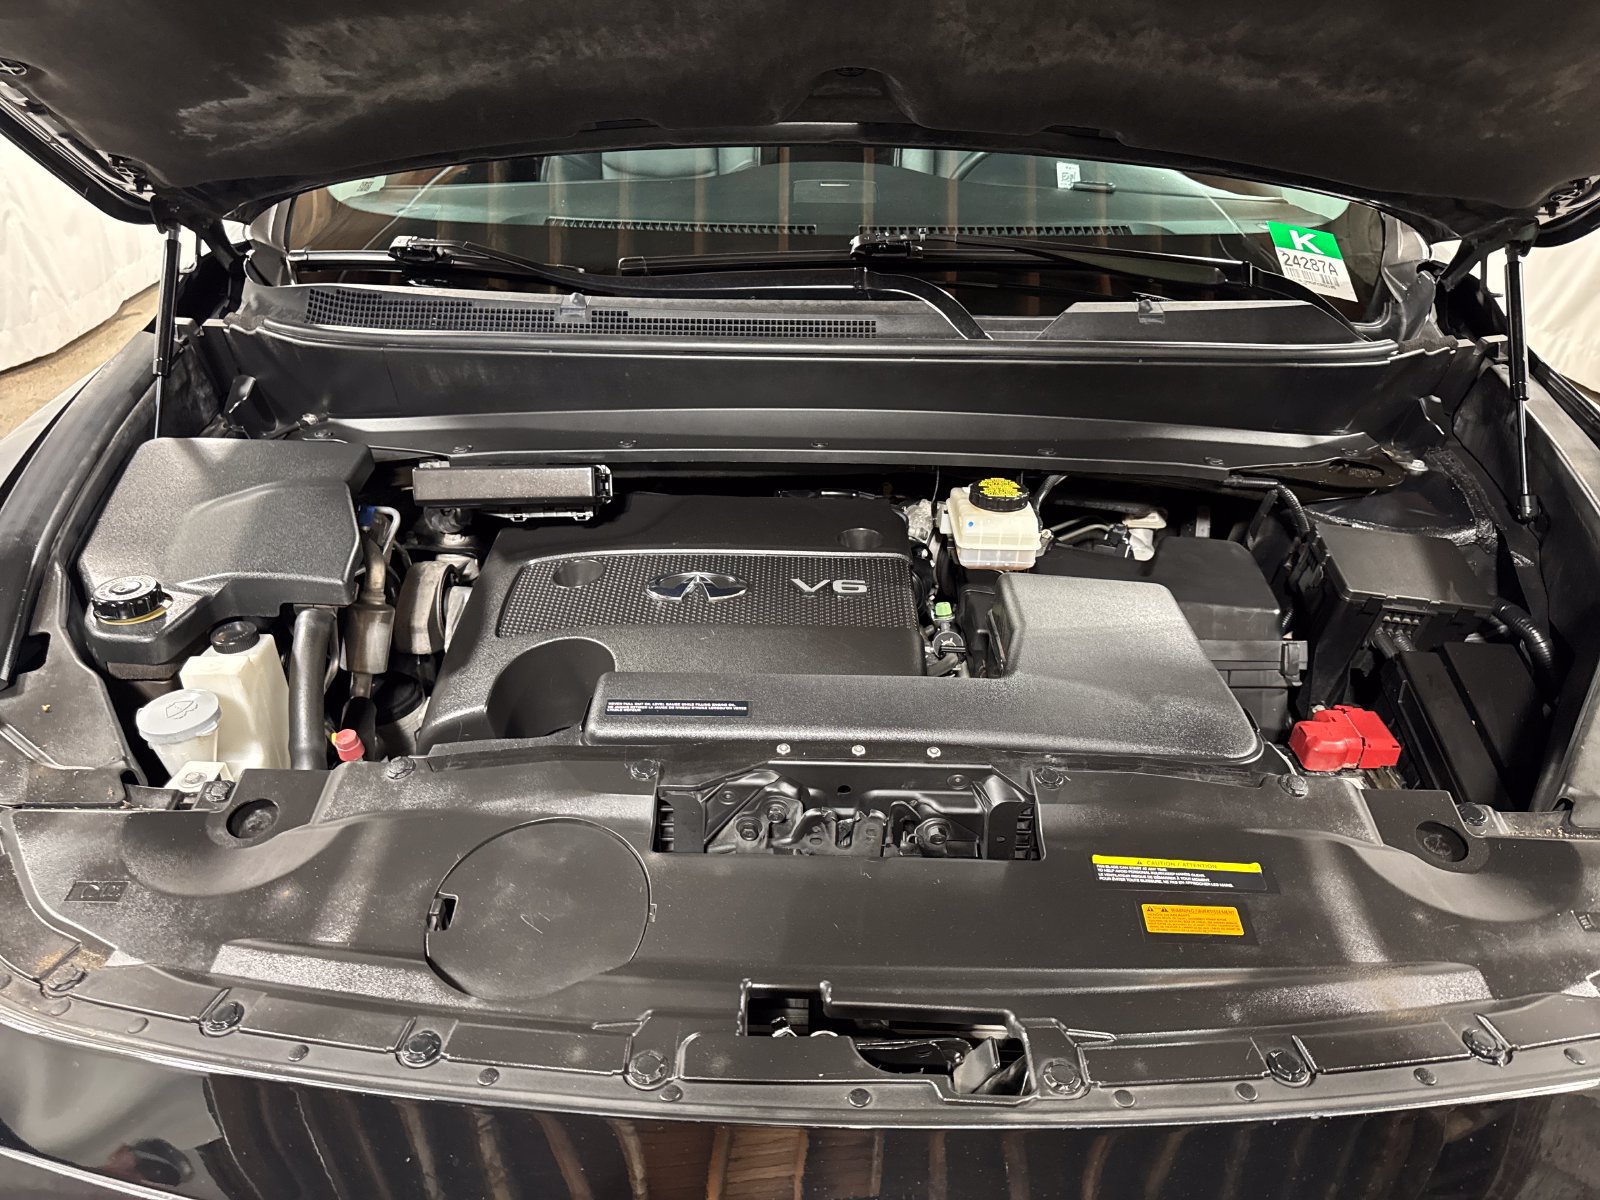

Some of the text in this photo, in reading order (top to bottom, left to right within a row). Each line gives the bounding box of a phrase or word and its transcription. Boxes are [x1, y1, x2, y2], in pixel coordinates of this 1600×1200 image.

[1289, 230, 1324, 255] K
[1281, 252, 1338, 276] 24287A
[790, 578, 868, 594] V6
